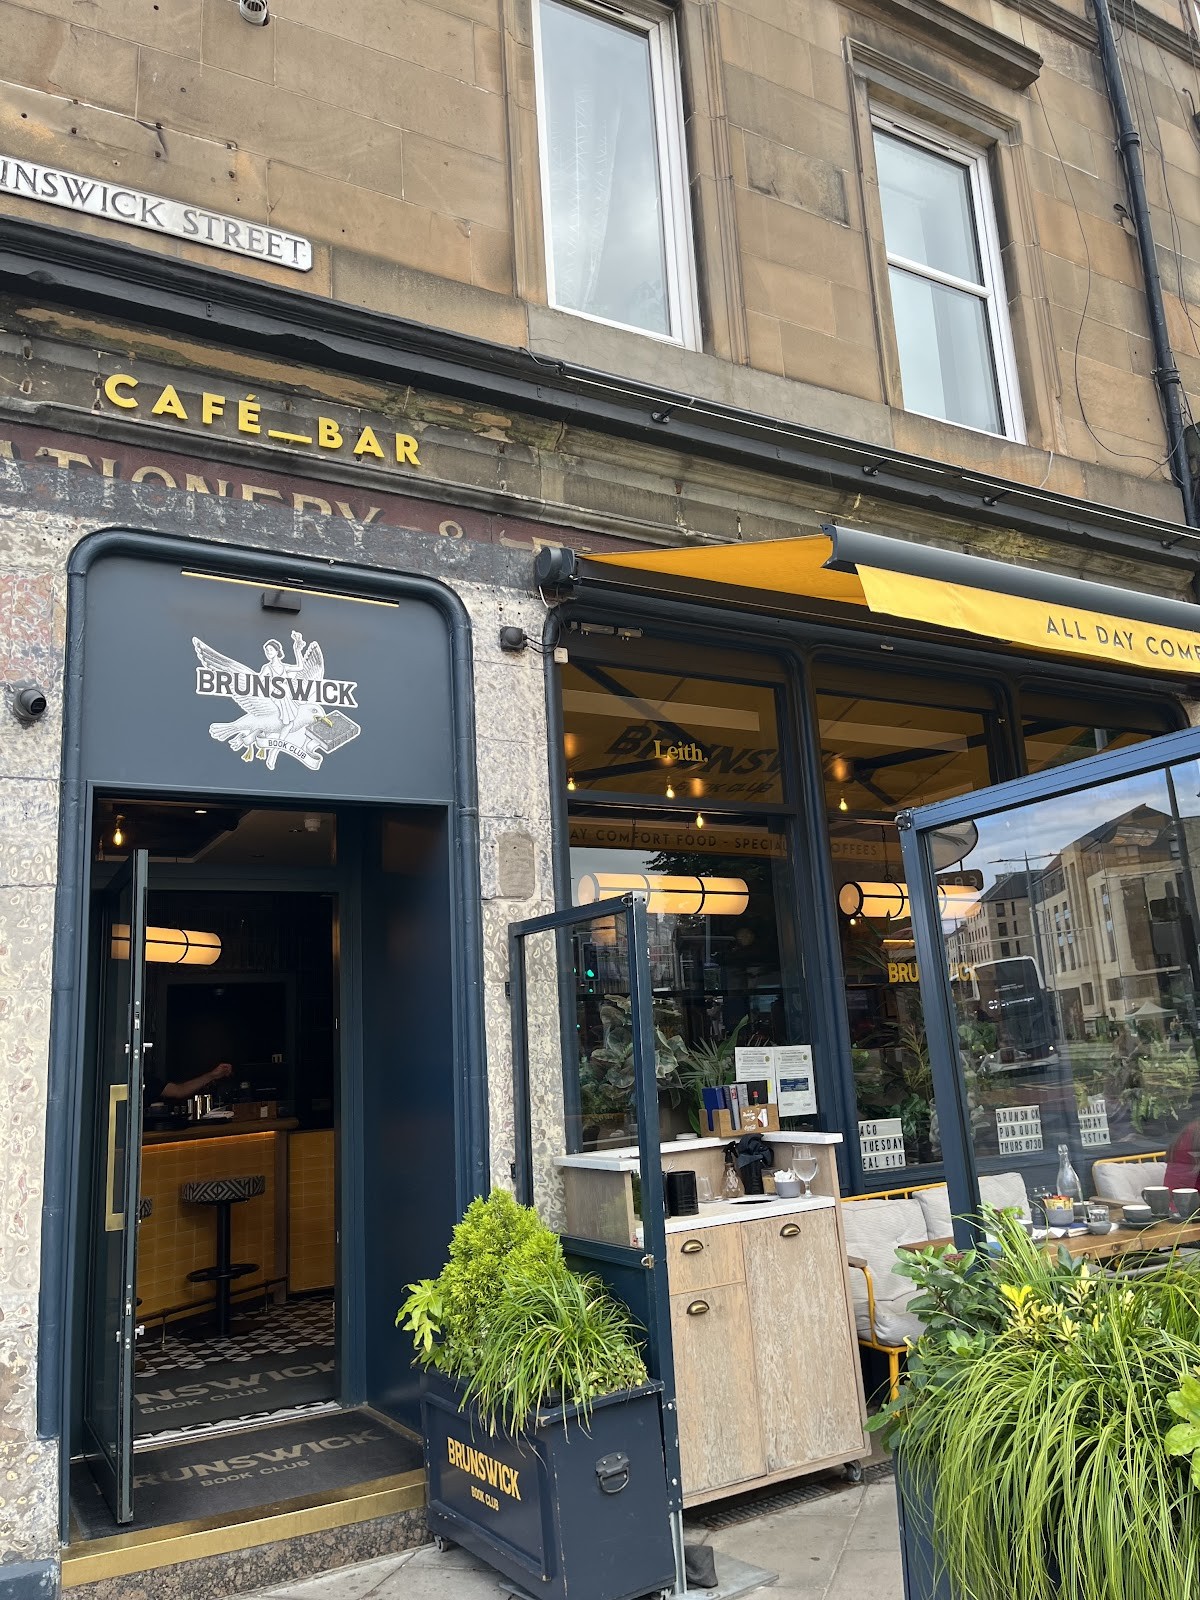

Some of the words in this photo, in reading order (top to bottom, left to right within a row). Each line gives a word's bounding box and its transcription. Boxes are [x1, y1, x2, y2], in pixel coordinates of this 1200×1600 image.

[182, 209, 306, 264] STREET
[1046, 616, 1087, 640] ALL
[1096, 625, 1133, 650] DAY
[197, 669, 357, 706] BRUNSWICK
[268, 739, 289, 749] BOOK
[289, 746, 307, 759] CLUB
[653, 739, 709, 763] Leith.
[596, 829, 670, 846] COMFORT
[676, 833, 717, 847] FOOD
[999, 1125, 1016, 1138] PUB
[1019, 1123, 1039, 1136] QUIZ
[863, 1137, 904, 1153] TUESDAY
[1000, 1141, 1023, 1154] THURS
[885, 1154, 903, 1166] £10
[140, 1399, 203, 1415] BOOK
[209, 1387, 270, 1402] CLUB
[200, 1472, 254, 1488] BOOK
[259, 1459, 311, 1476] CLUB
[447, 1436, 522, 1501] BRUNSWICK
[470, 1485, 486, 1503] BOOK
[484, 1493, 500, 1512] CLUB
